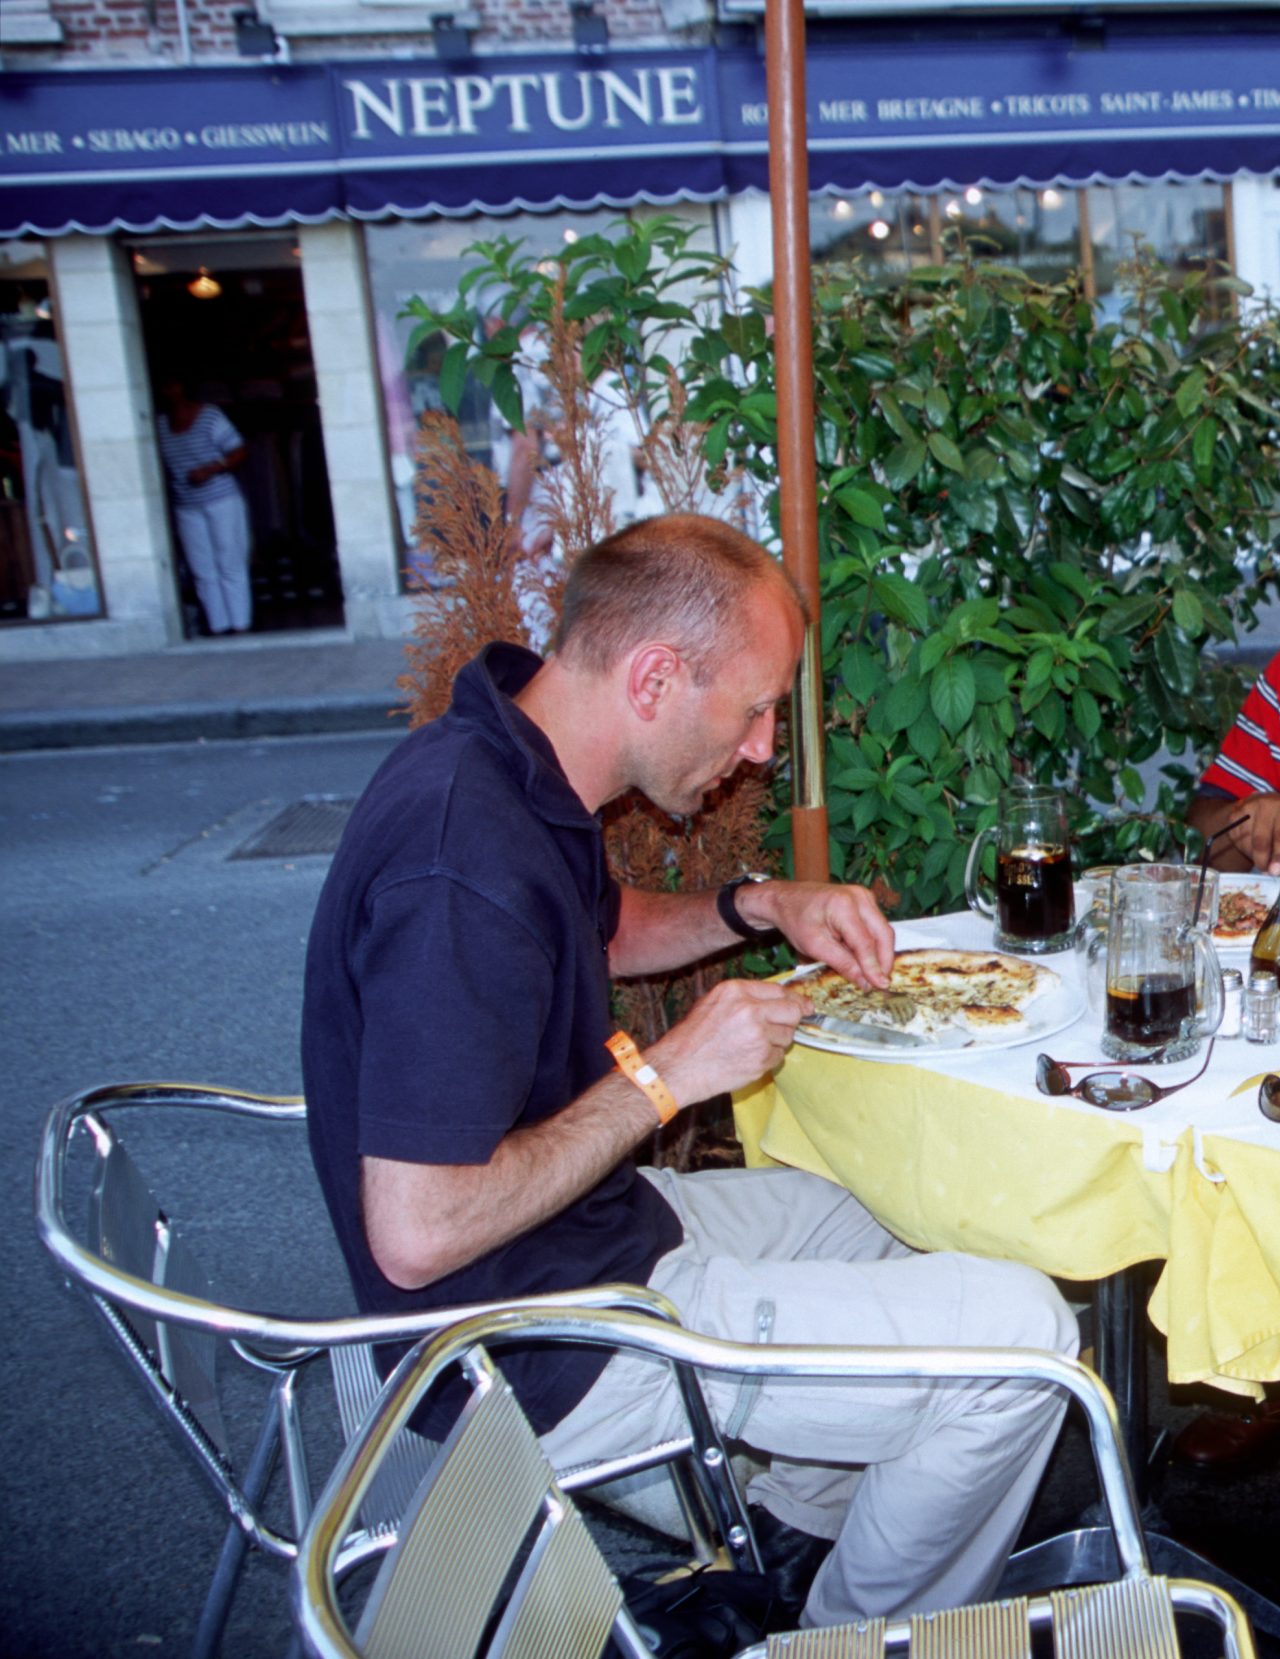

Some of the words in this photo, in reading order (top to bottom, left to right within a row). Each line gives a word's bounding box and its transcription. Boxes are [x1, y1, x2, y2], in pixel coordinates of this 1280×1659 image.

[342, 66, 702, 138] NEPTUNE
[819, 101, 867, 123] MER
[877, 97, 983, 121] BRETAGNE
[1005, 94, 1090, 117] TRICOTS
[6, 131, 63, 154] MER
[88, 127, 181, 151] SEBAGO
[201, 121, 330, 149] GIESSWEIN
